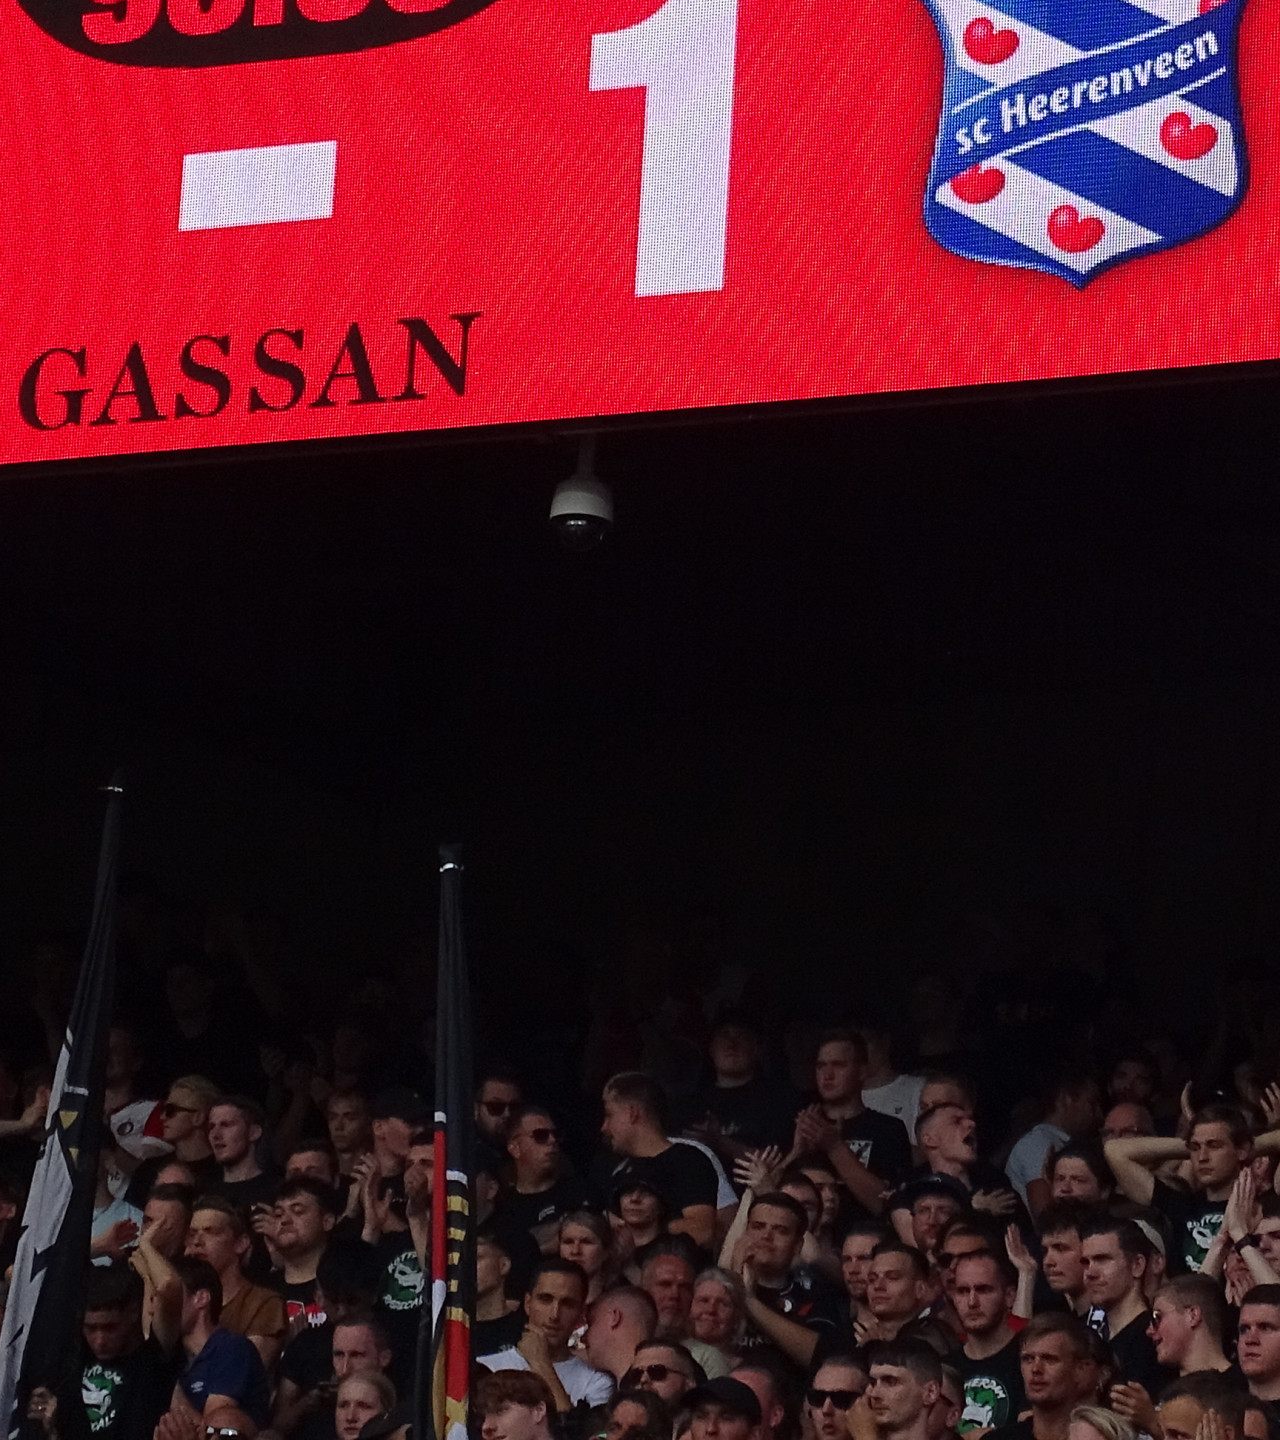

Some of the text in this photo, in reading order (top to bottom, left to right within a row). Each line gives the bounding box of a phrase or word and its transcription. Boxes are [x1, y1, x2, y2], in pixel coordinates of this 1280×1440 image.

[955, 29, 1220, 156] sc Heerenveen
[19, 311, 483, 431] GASSAN
